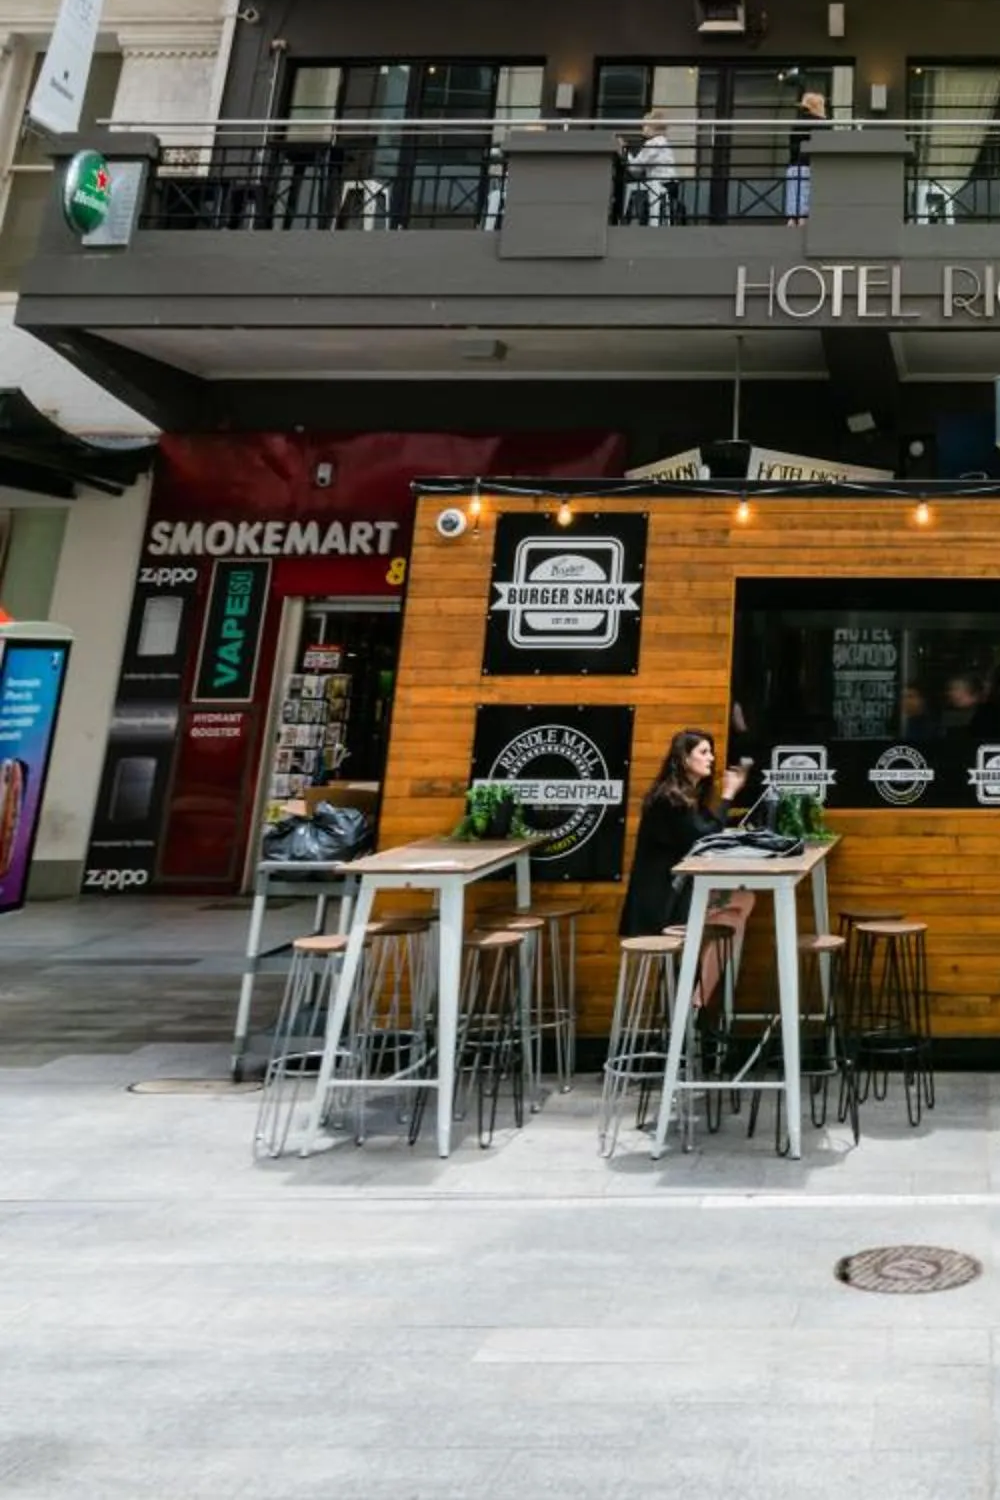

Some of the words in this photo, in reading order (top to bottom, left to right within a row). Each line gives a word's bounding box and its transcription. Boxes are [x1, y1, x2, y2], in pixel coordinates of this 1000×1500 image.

[735, 265, 921, 318] HOTEL
[148, 521, 399, 556] SMOKEMART
[139, 567, 198, 587] zippo
[507, 587, 569, 605] BURGER
[573, 587, 627, 605] SHACK
[193, 713, 243, 723] HYDRANT
[190, 727, 241, 737] BOOSTER
[500, 729, 558, 770] RUNDLE
[561, 730, 600, 771] MALL
[543, 784, 620, 800] CENTRAL
[84, 868, 149, 890] zippo
